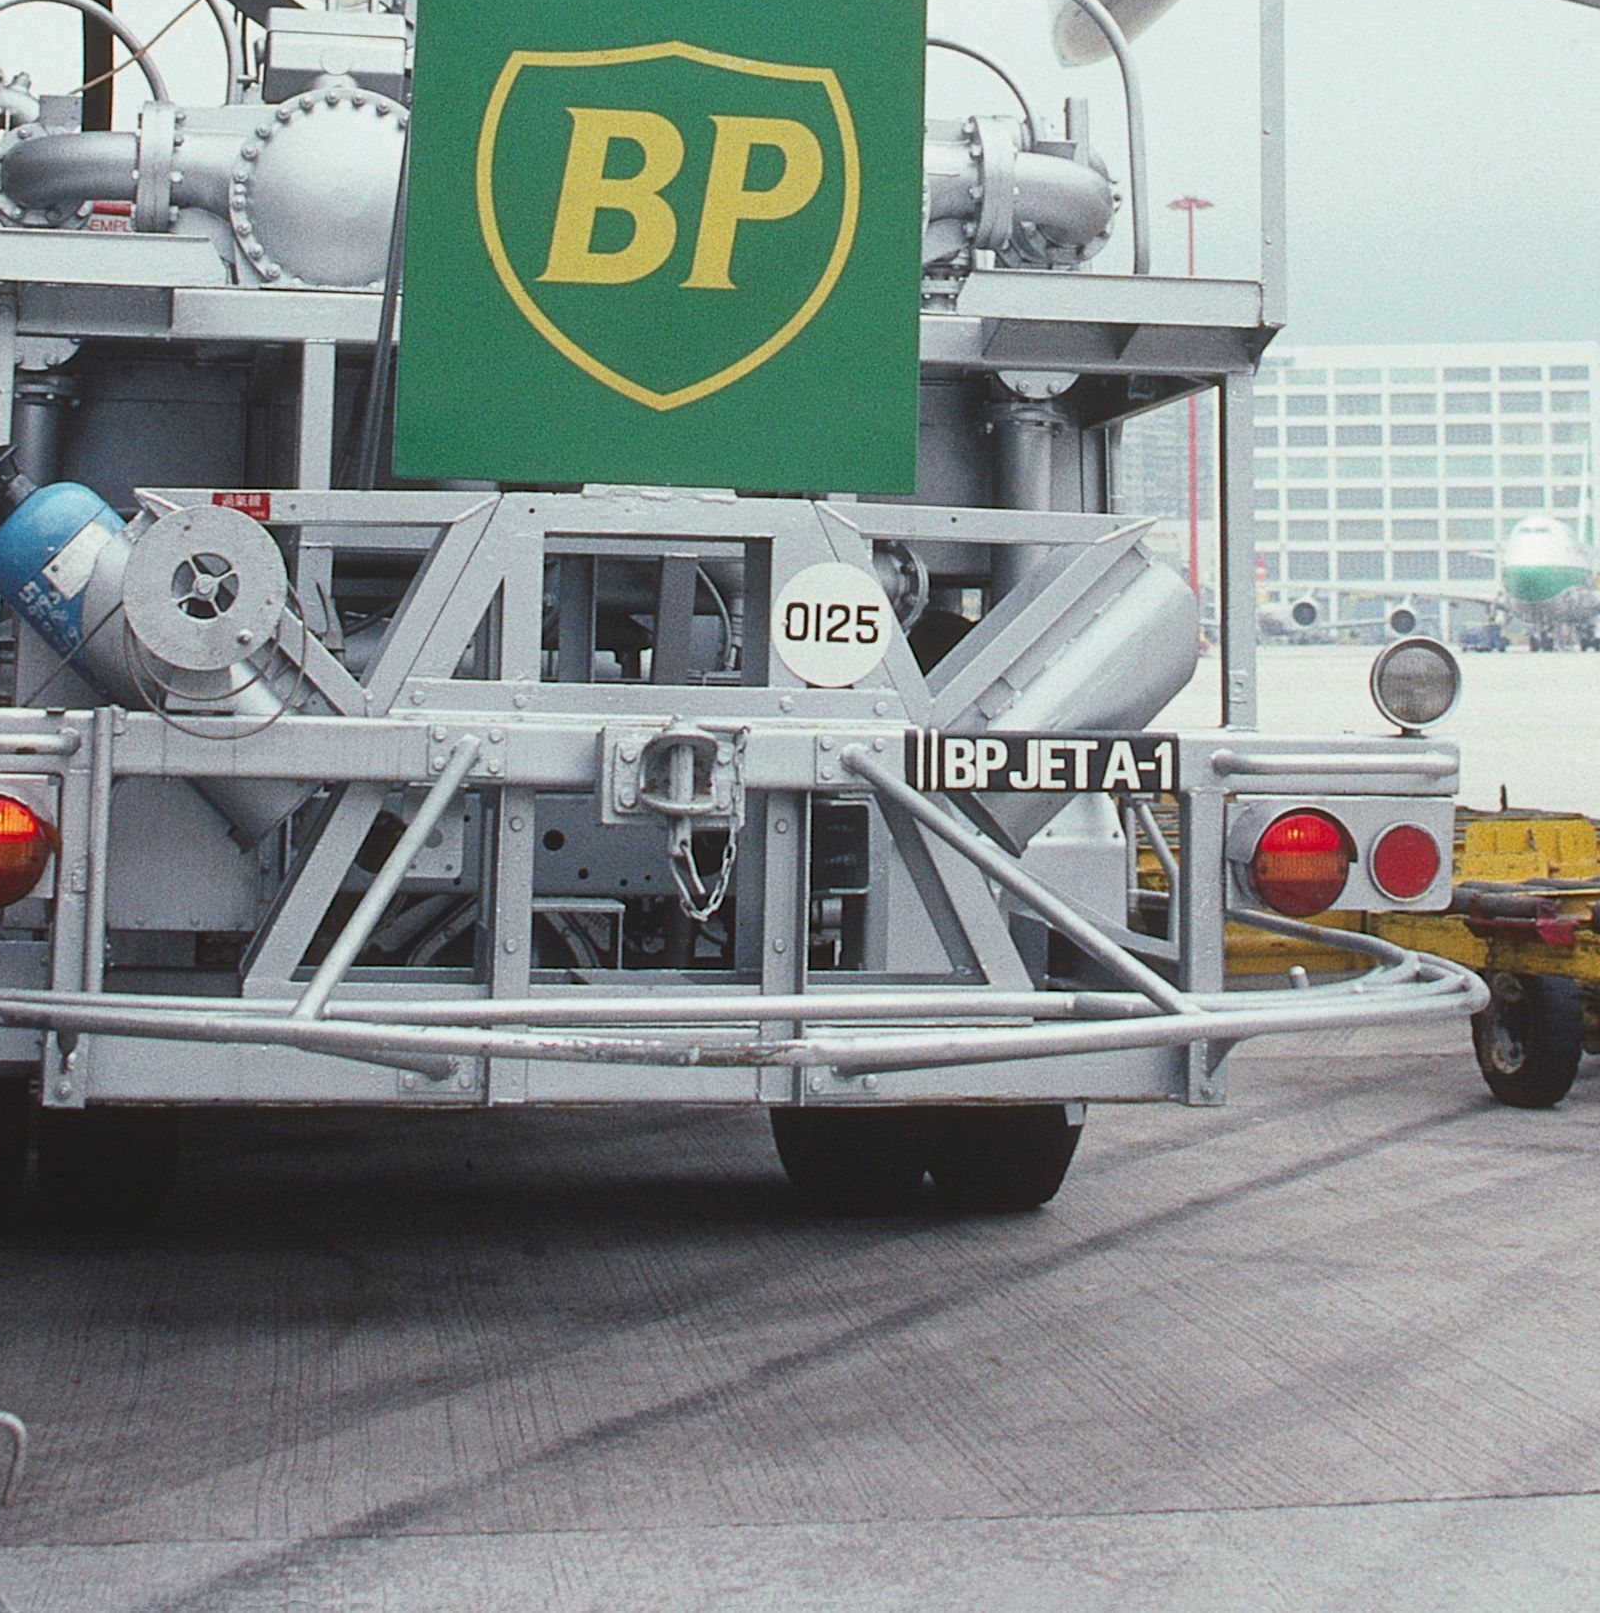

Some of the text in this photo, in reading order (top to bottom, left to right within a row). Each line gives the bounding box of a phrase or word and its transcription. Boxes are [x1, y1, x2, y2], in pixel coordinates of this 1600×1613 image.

[535, 106, 823, 290] BP
[784, 601, 880, 644] 0125
[943, 737, 1173, 790] BP JET A-1
